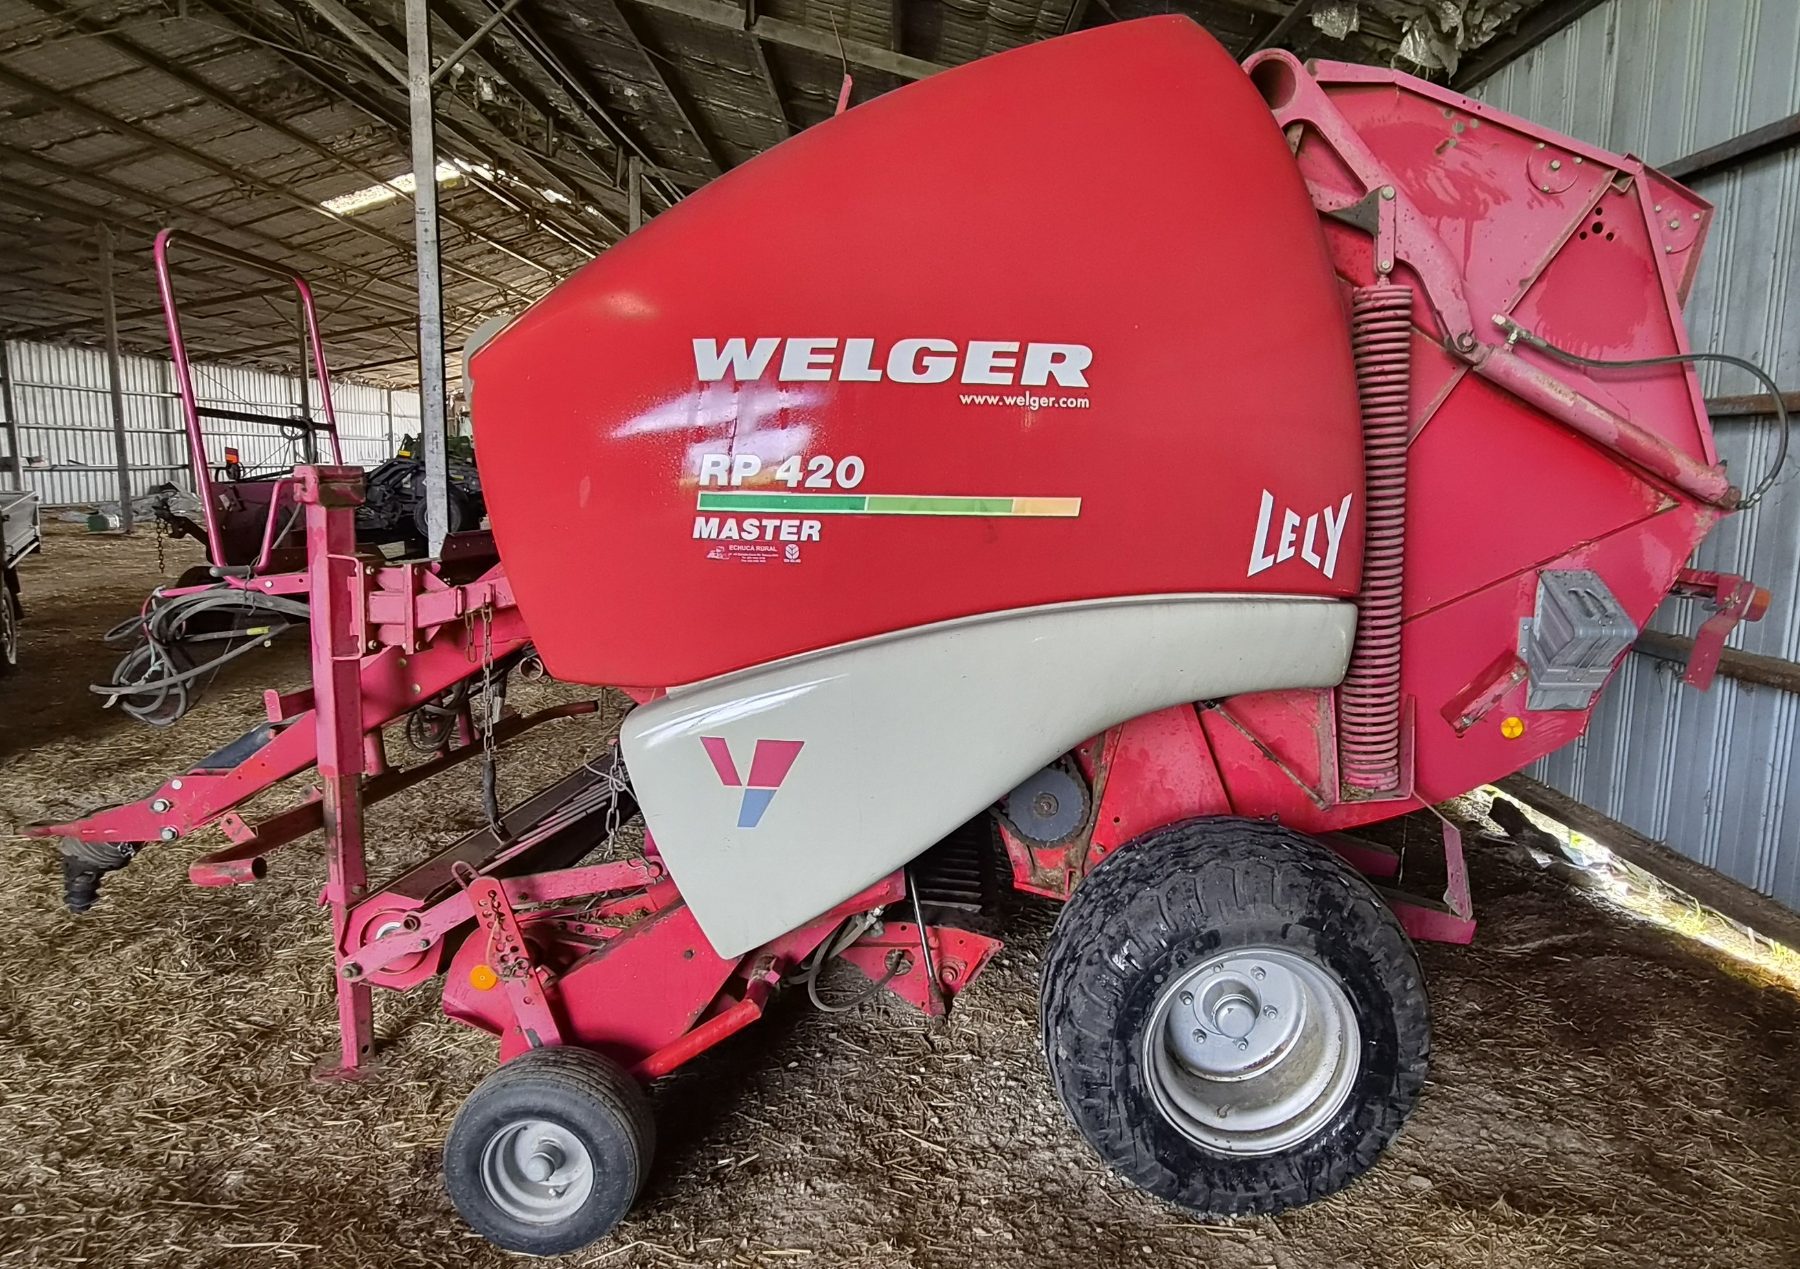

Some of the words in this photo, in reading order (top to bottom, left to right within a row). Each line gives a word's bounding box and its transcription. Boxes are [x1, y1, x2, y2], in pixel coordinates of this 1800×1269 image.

[692, 337, 1093, 388] WELGER
[959, 391, 1090, 411] www.welger.com
[699, 454, 762, 486] RP
[775, 455, 865, 489] 420
[692, 517, 822, 541] MASTER
[1247, 488, 1353, 580] LELY
